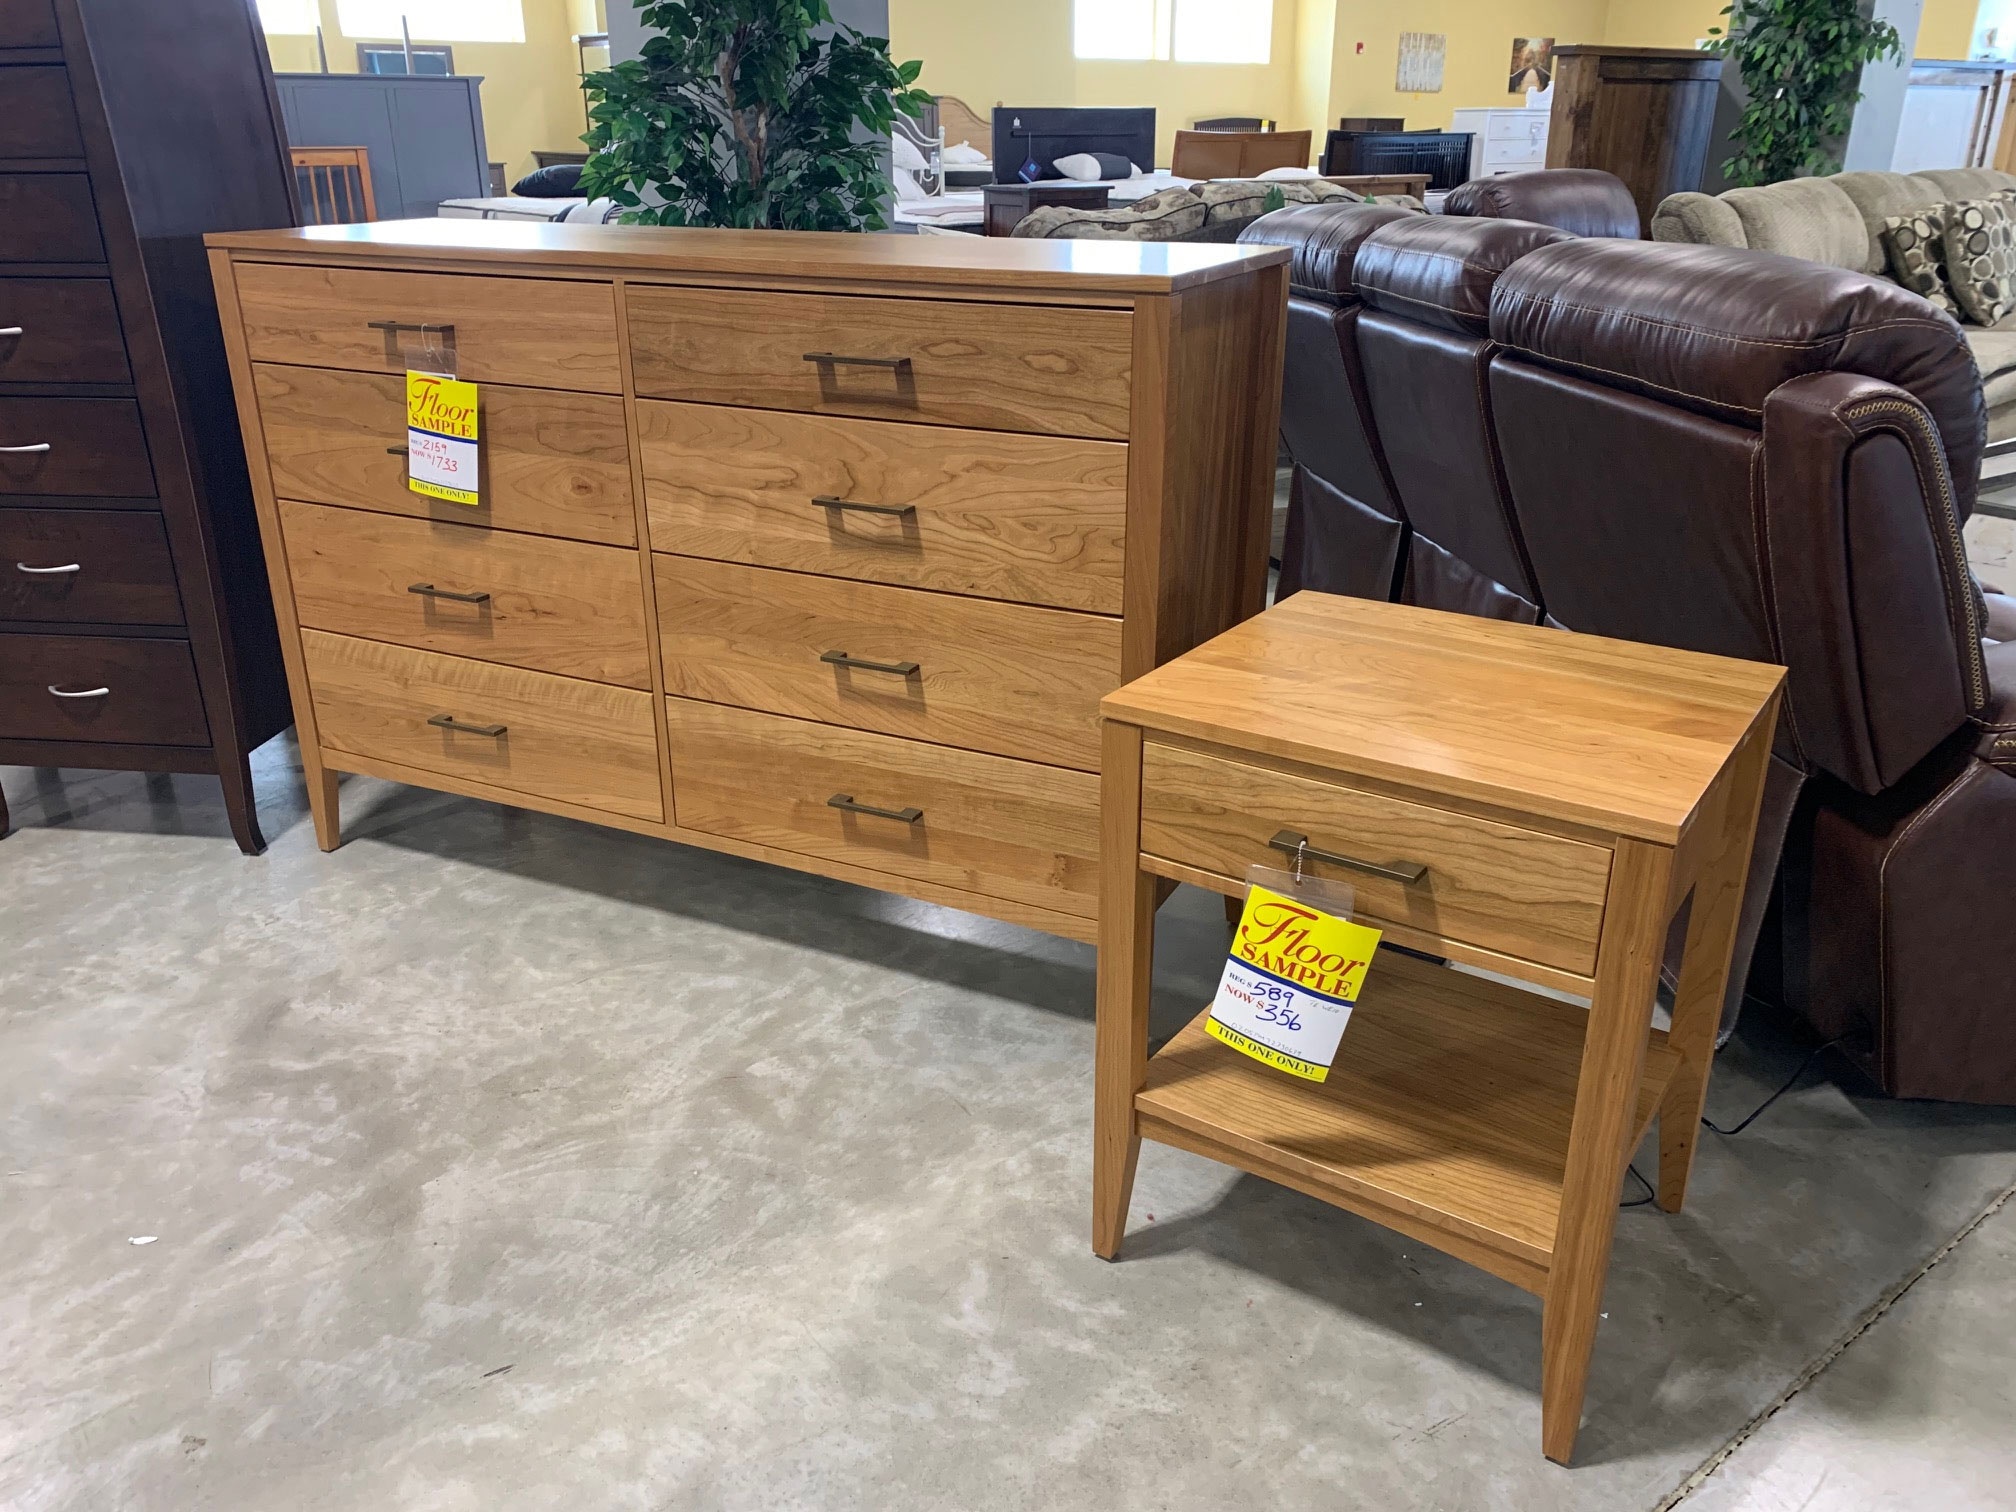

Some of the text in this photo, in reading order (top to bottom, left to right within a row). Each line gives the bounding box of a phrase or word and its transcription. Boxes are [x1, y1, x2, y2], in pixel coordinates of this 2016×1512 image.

[409, 378, 475, 422] Floor
[411, 412, 472, 438] SAMPLE
[414, 481, 470, 500] THIS ONE ONLY!
[1242, 902, 1366, 977] Floor
[1240, 942, 1353, 998] SAMPLE
[1224, 983, 1256, 1005] NOW
[1217, 1025, 1315, 1075] THIS ONE ONLY!
